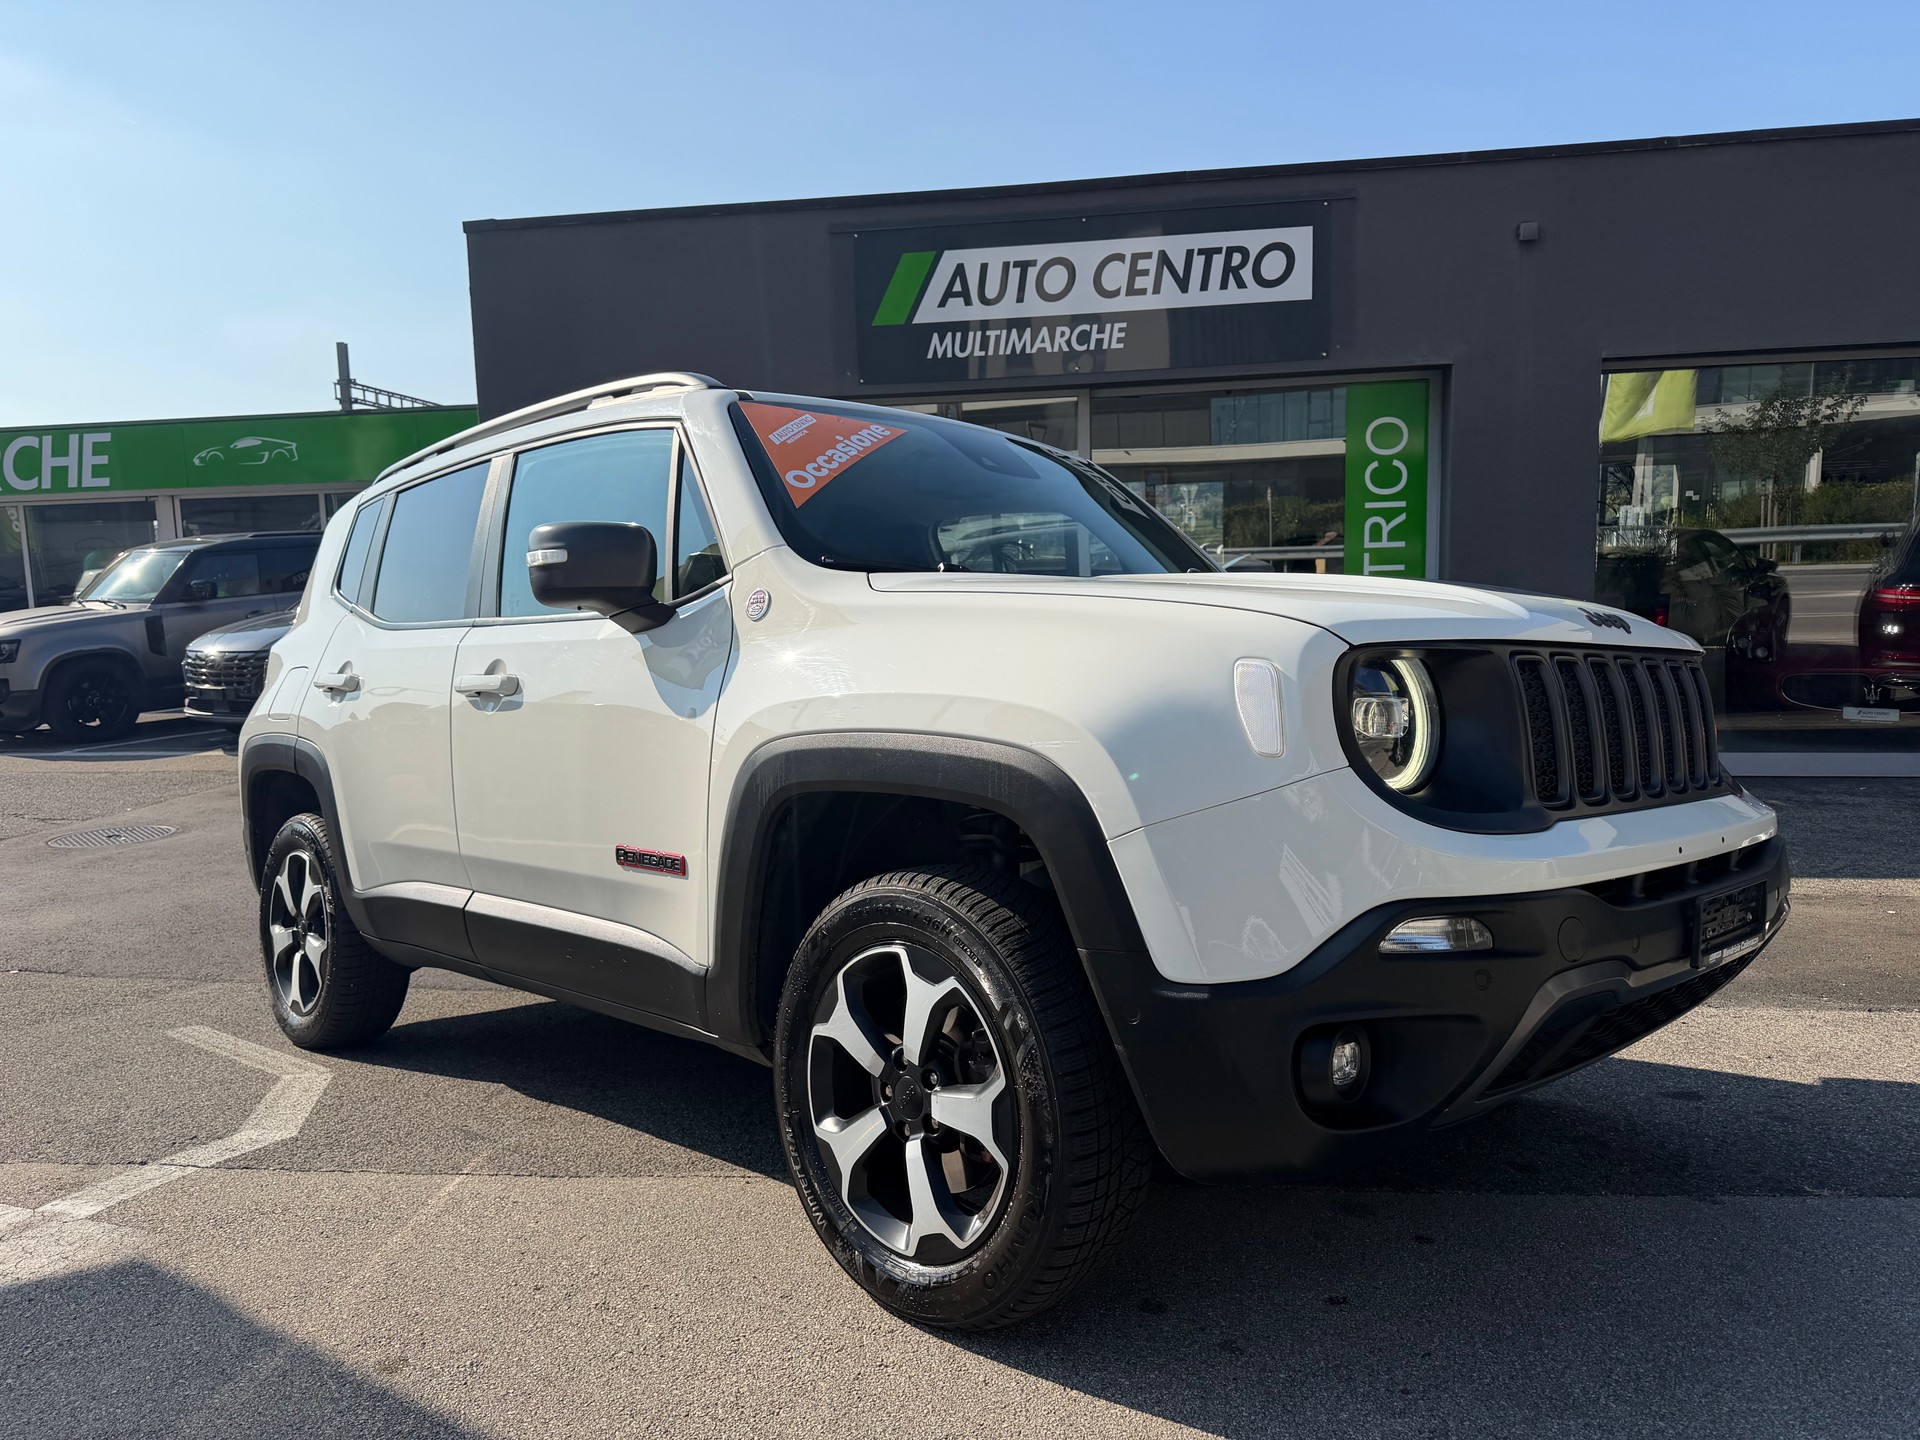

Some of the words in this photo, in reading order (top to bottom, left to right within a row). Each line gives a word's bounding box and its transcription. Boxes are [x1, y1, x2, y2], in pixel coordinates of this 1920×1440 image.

[937, 255, 1076, 308] AUTO
[1092, 241, 1297, 299] CENTRO
[926, 322, 1128, 360] MULTIMARCHE
[0, 432, 111, 491] CHE
[615, 844, 686, 876] RENEGADE
